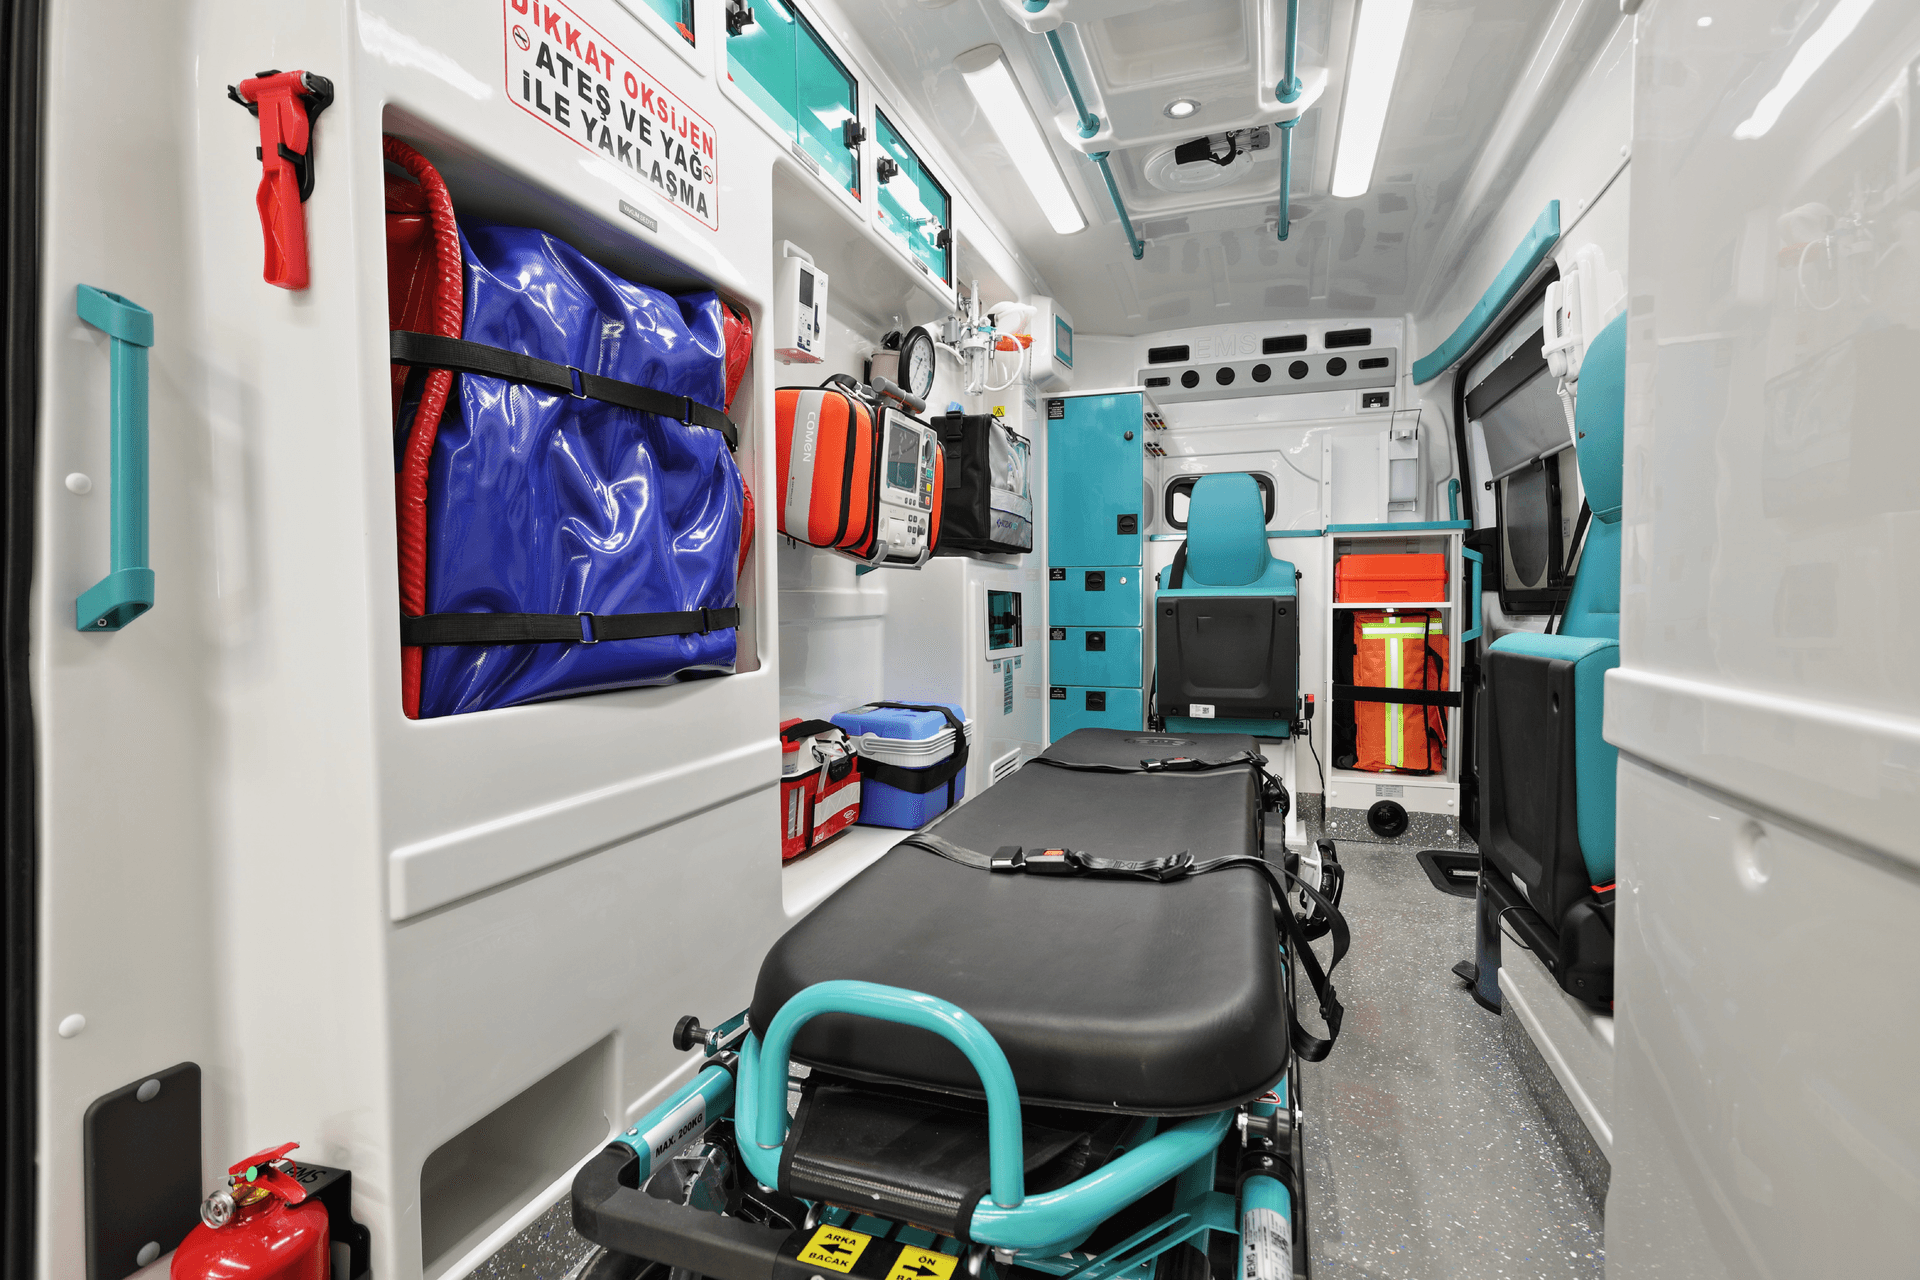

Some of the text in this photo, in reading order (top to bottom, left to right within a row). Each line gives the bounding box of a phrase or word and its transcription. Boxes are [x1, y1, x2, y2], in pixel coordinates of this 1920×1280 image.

[535, 41, 702, 182] ATEŞ VE YAĞ
[581, 109, 709, 219] YAKLAŞMA
[1193, 331, 1258, 360] EMS
[655, 1113, 703, 1158] MAX. 200KG
[284, 1166, 327, 1184] EMS
[824, 1233, 857, 1246] ARKA
[808, 1252, 937, 1268] BACAK ÖN
